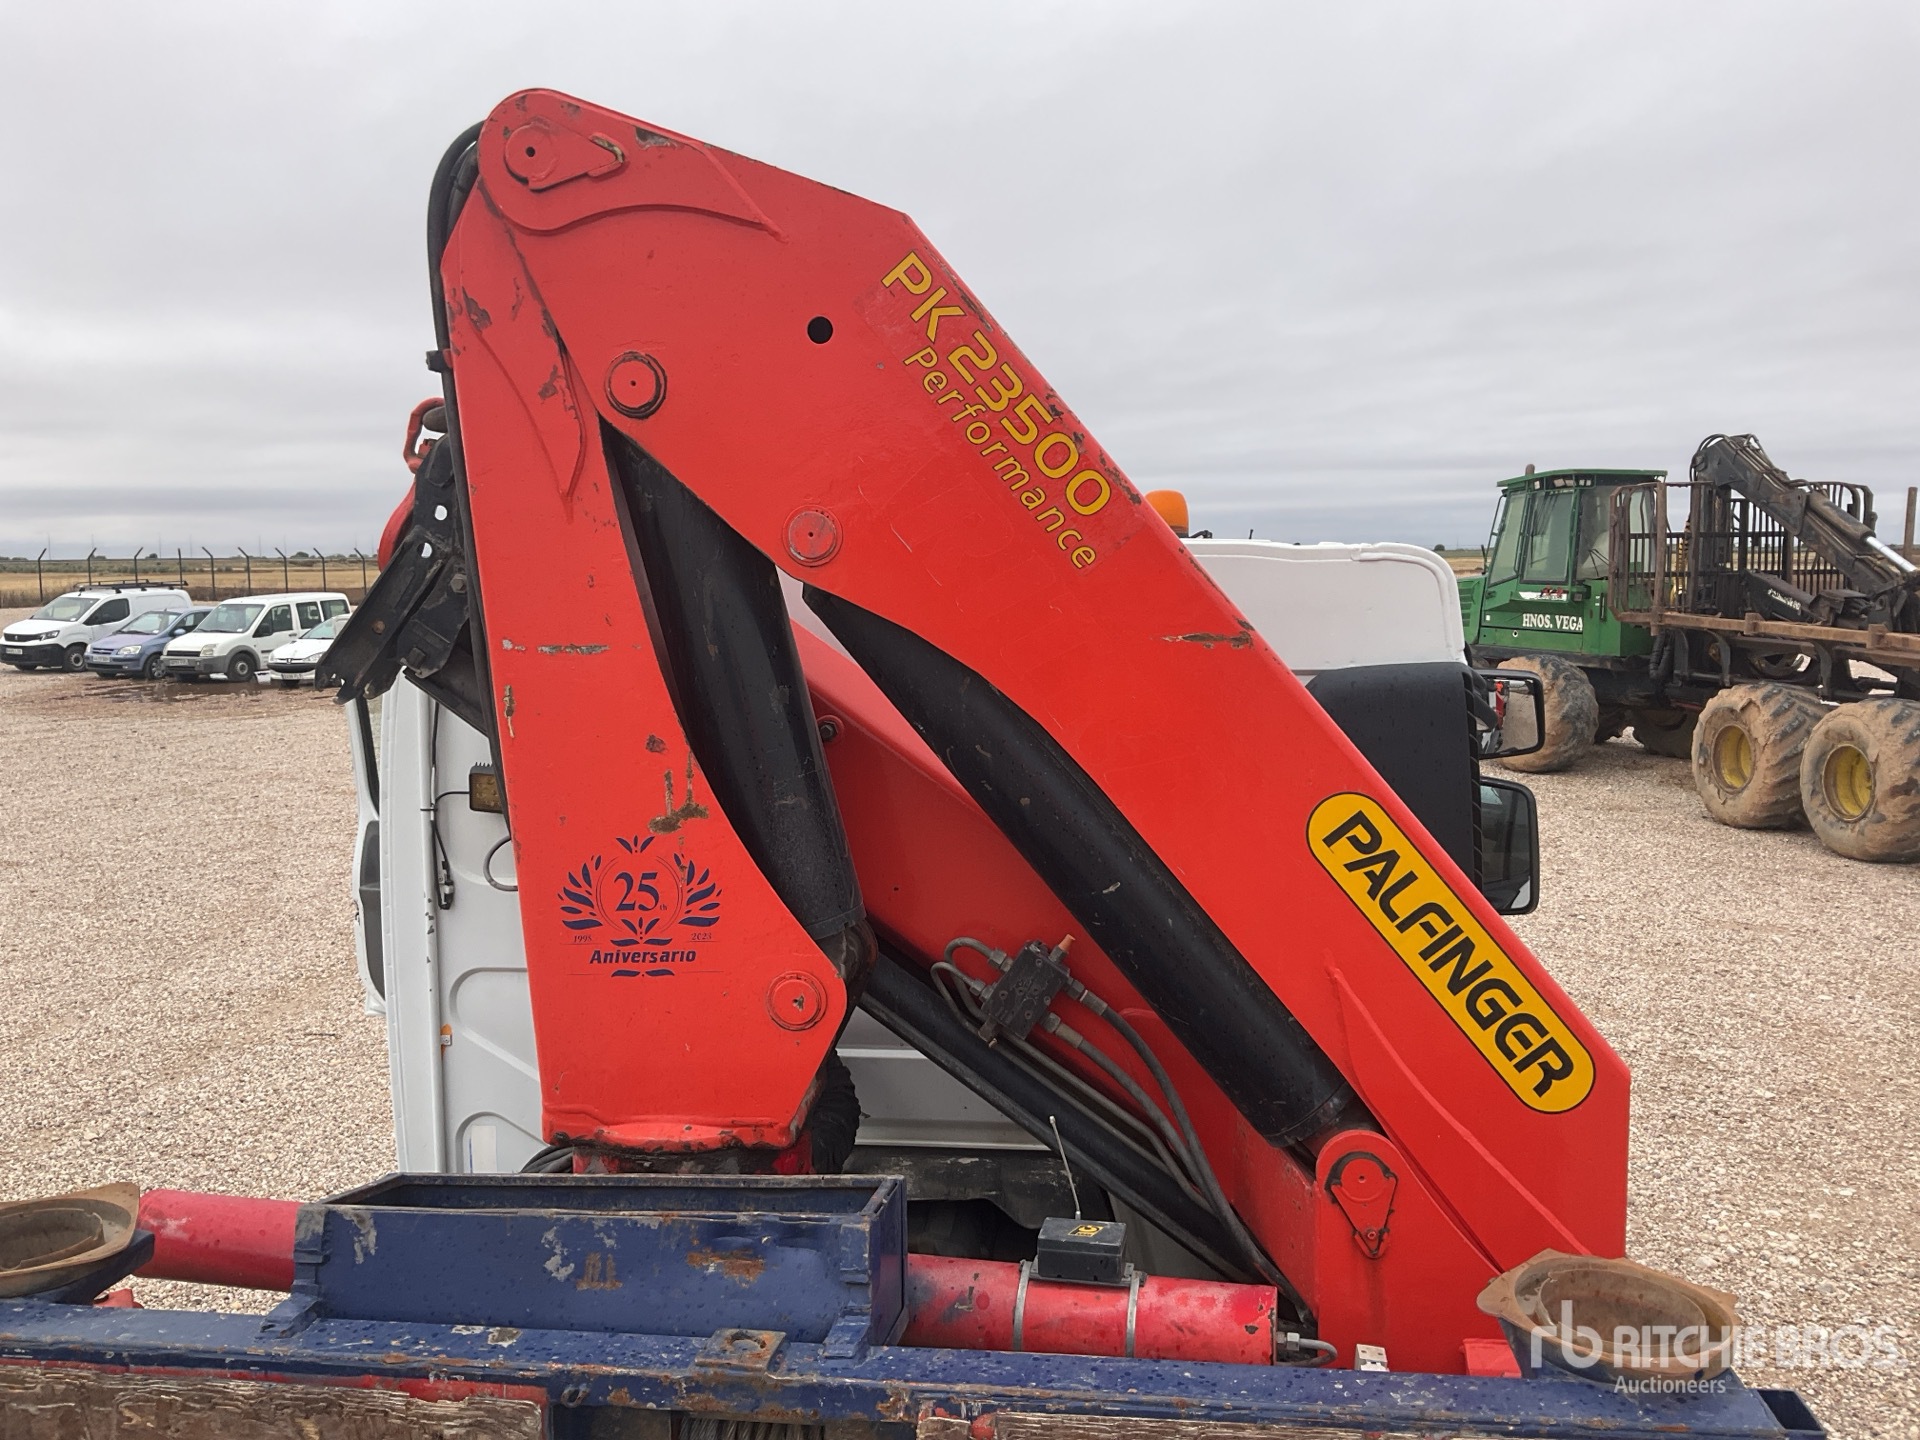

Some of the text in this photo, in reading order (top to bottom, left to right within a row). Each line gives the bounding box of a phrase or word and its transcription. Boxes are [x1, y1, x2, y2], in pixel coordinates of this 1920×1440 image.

[881, 251, 1111, 516] PK 23500
[903, 346, 1097, 570] Performance
[1522, 613, 1583, 631] HNOS. VEGA
[589, 950, 697, 964] Aniversario
[1321, 809, 1574, 1098] PALFINGER
